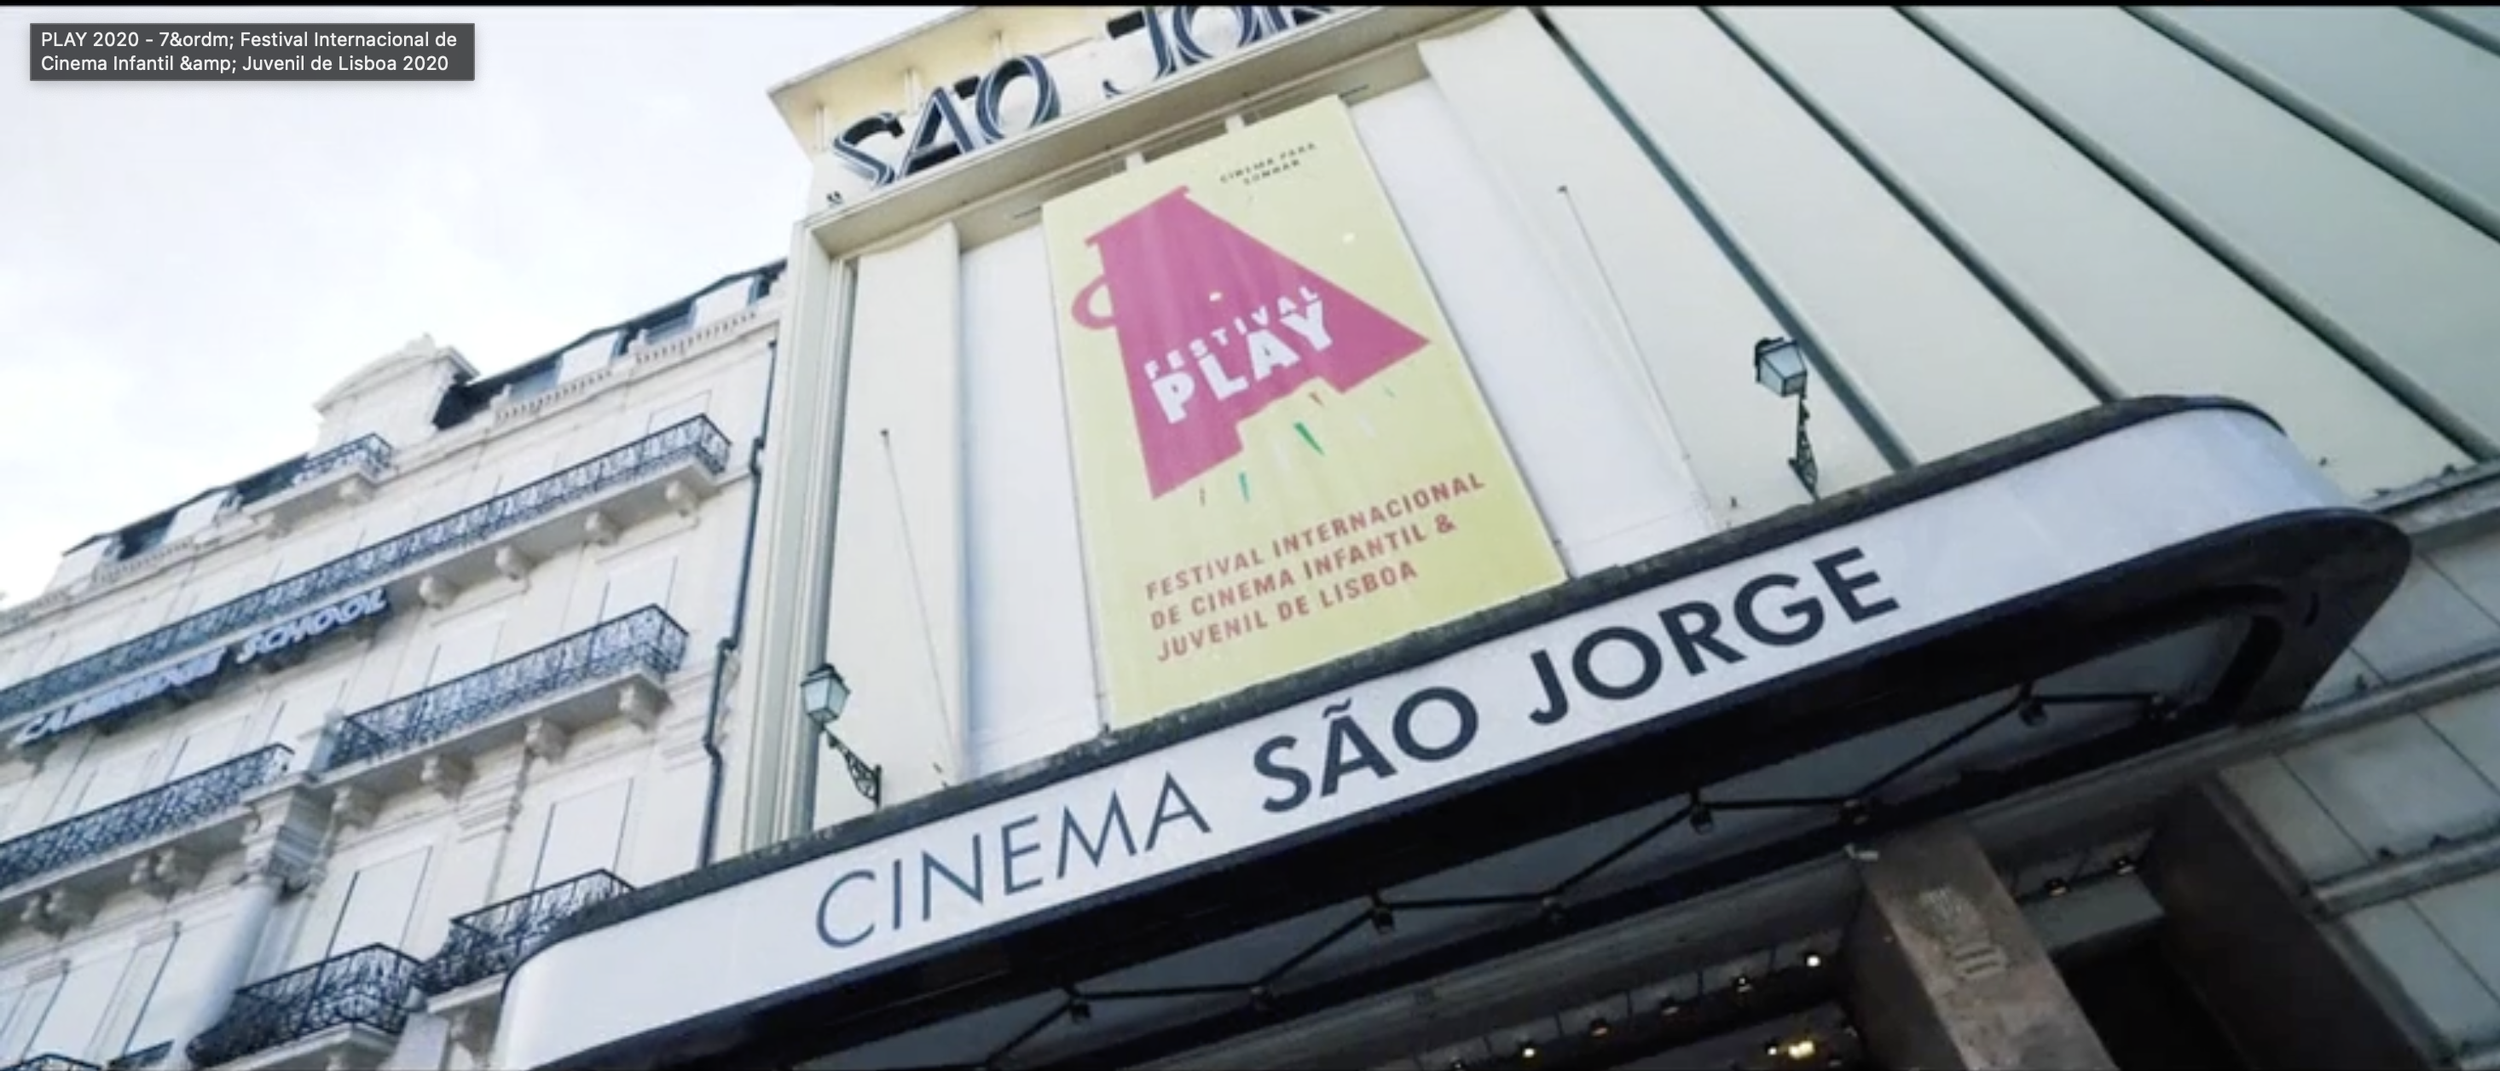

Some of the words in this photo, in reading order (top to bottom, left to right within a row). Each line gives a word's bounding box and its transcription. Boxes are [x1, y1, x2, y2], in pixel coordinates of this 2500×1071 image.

[1144, 286, 1319, 381] FESTIVAL
[1151, 299, 1333, 425] PLAY
[1145, 547, 1265, 602] FESTIVAL
[1271, 472, 1486, 559] INTERNACIONAL
[1150, 609, 1181, 631] DE
[1190, 568, 1295, 618] CINEMA
[1302, 522, 1427, 582] INFANTIL
[1435, 512, 1457, 535] &
[236, 586, 387, 664] SCHOOL
[1157, 612, 1268, 663] JUVENIL
[1277, 595, 1310, 623] DE
[1319, 559, 1418, 609] LISBOA
[816, 773, 1212, 948] CINEMA
[1254, 686, 1479, 814] SÃO
[1529, 546, 1900, 725] JORGE
